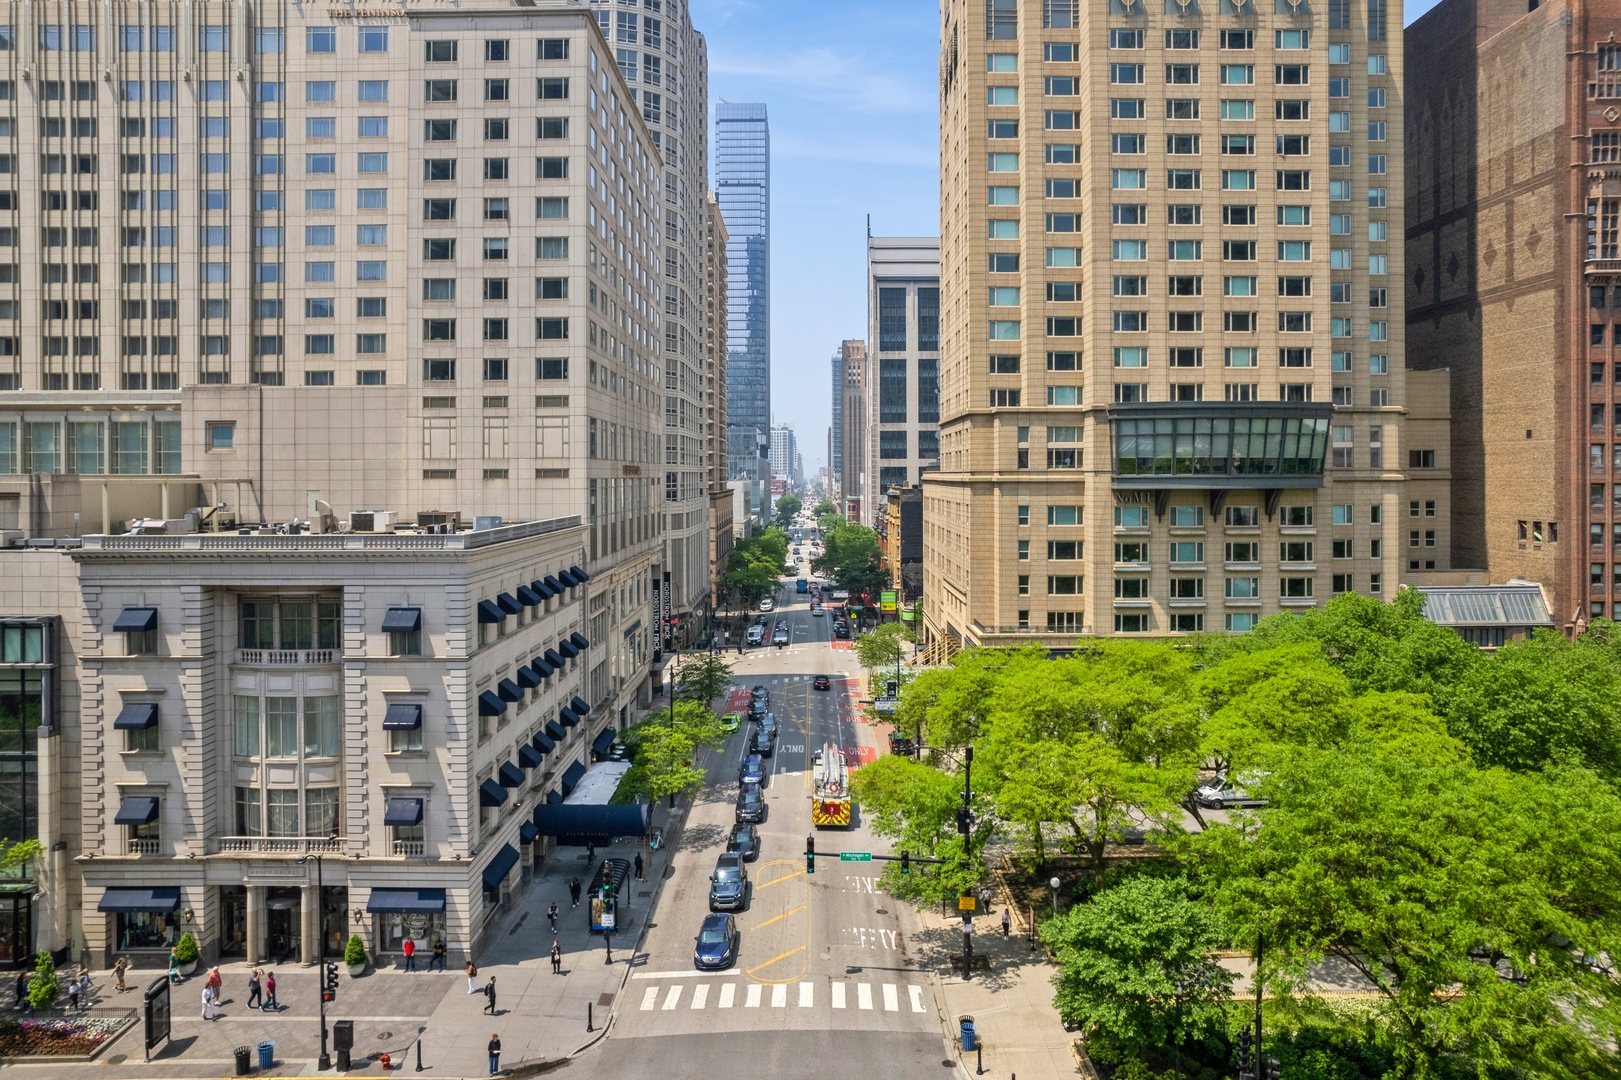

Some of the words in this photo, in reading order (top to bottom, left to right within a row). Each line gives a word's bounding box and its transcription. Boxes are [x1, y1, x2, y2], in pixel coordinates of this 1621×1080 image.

[327, 9, 352, 18] THE
[356, 8, 408, 18] PENINSU
[1116, 491, 1151, 504] NoMI
[653, 633, 661, 651] rack
[734, 699, 750, 707] BUS
[846, 715, 862, 723] BUS
[779, 744, 805, 753] ONLY
[848, 746, 869, 756] ONLY
